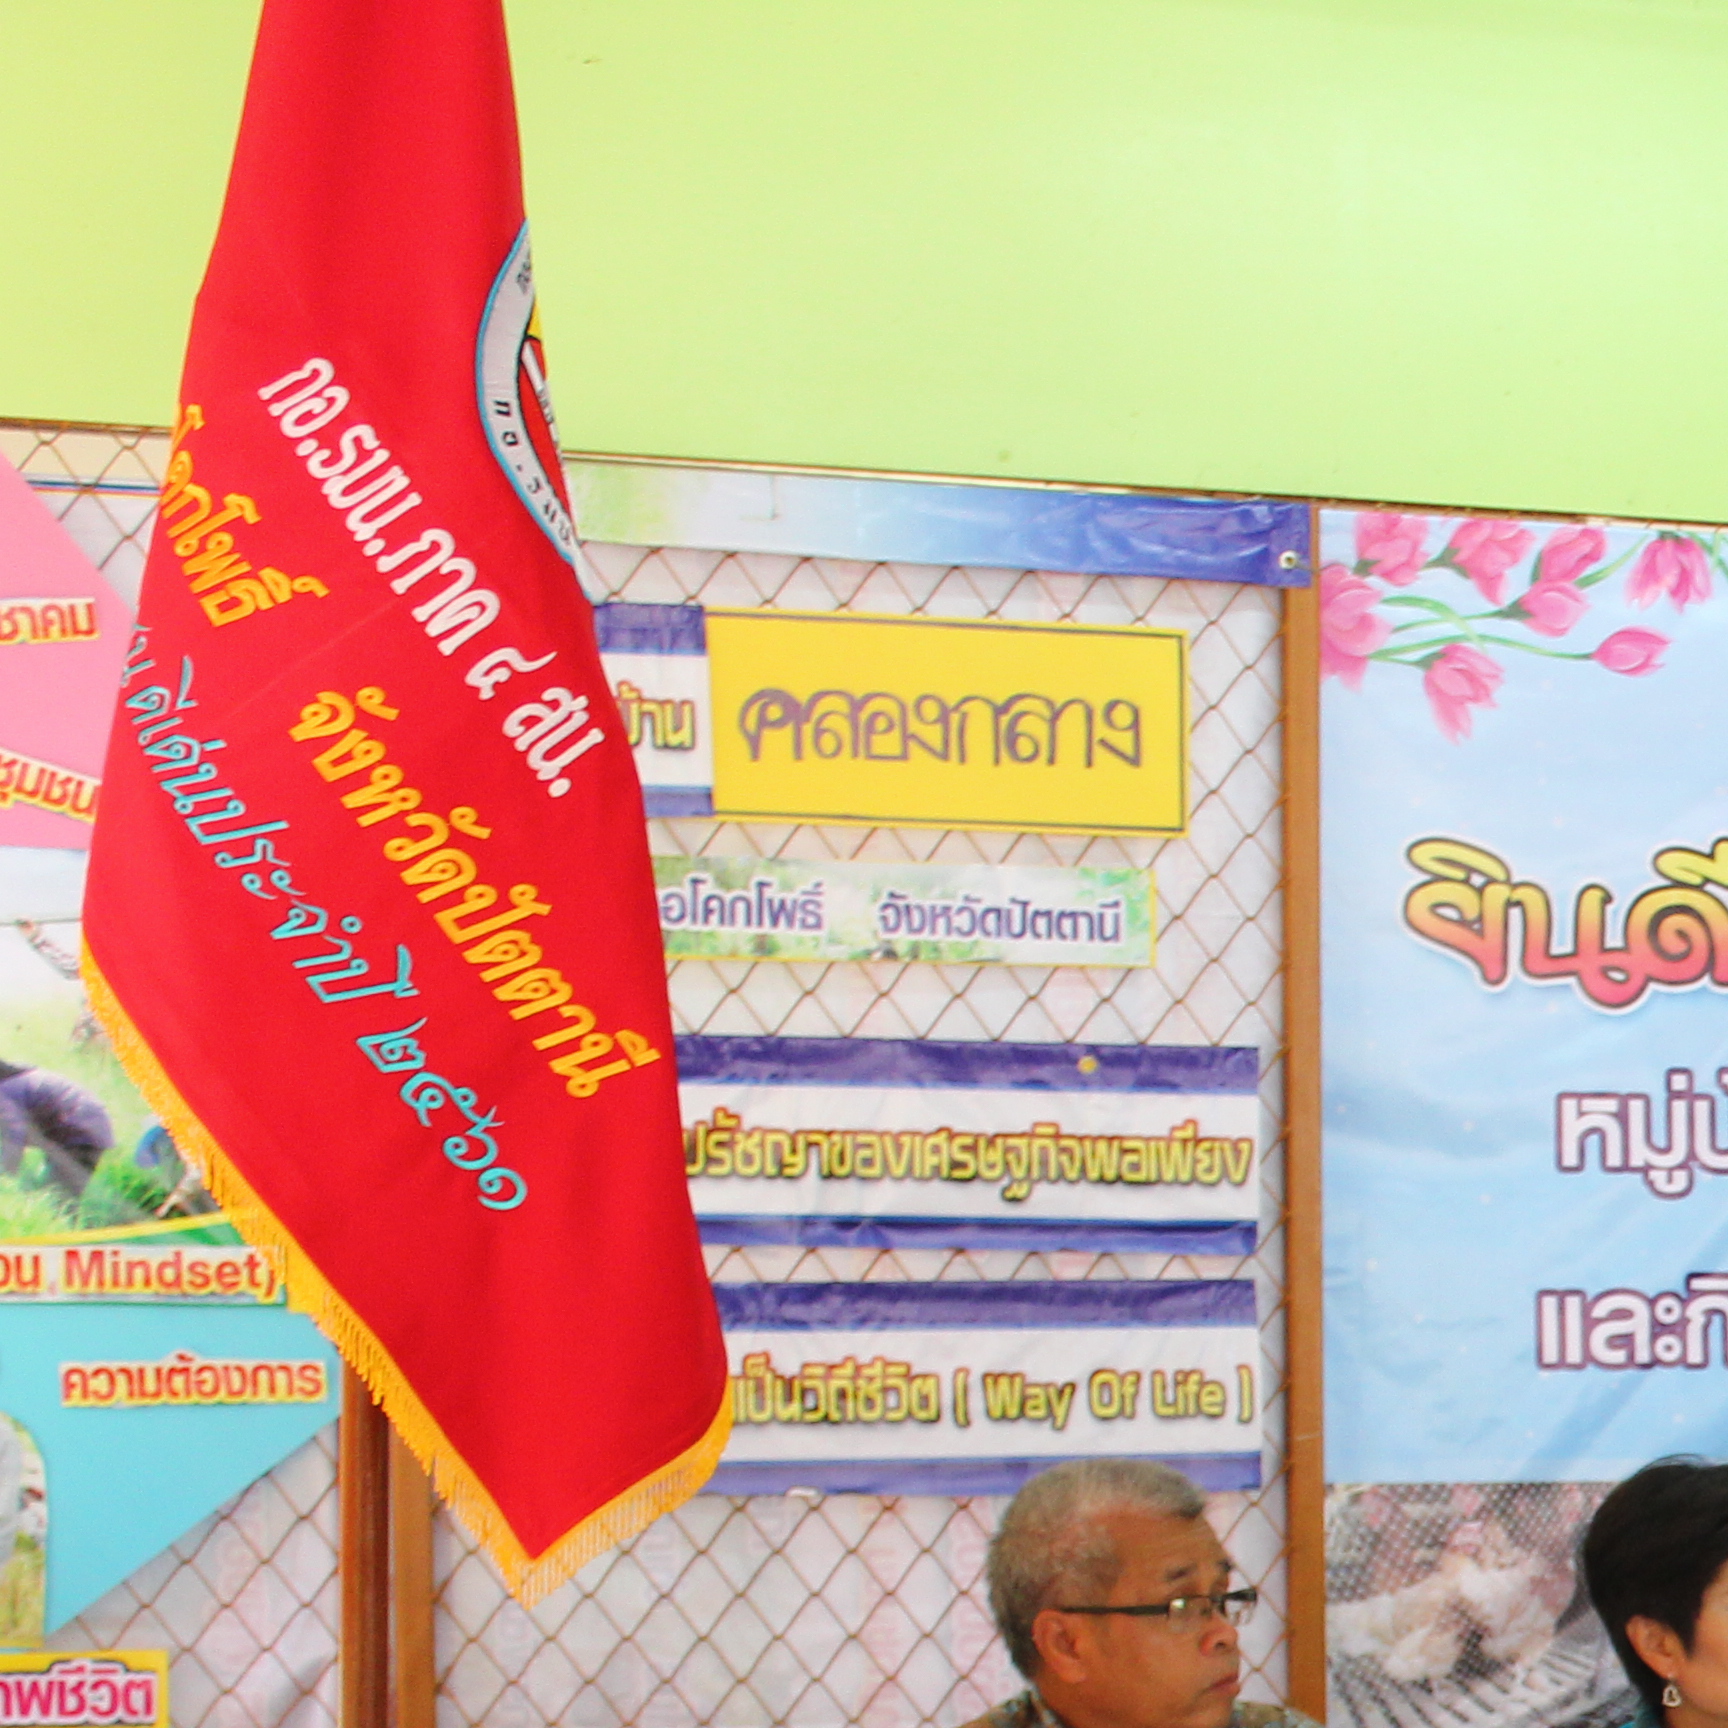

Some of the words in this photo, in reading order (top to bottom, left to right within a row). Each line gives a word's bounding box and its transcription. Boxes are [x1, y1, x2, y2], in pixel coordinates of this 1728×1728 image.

[465, 647, 557, 700] ๔
[738, 688, 1147, 768] คลองกลาง
[288, 686, 661, 1098] จังหวัดปัตตานี
[878, 890, 1122, 944] จังหวัดปัตตานี
[356, 1016, 527, 1211] ๒๕๖๑
[62, 1352, 324, 1404] ความต้องการ
[983, 1371, 1076, 1429] Way
[1088, 1367, 1142, 1421] Of
[1152, 1367, 1227, 1419] Life
